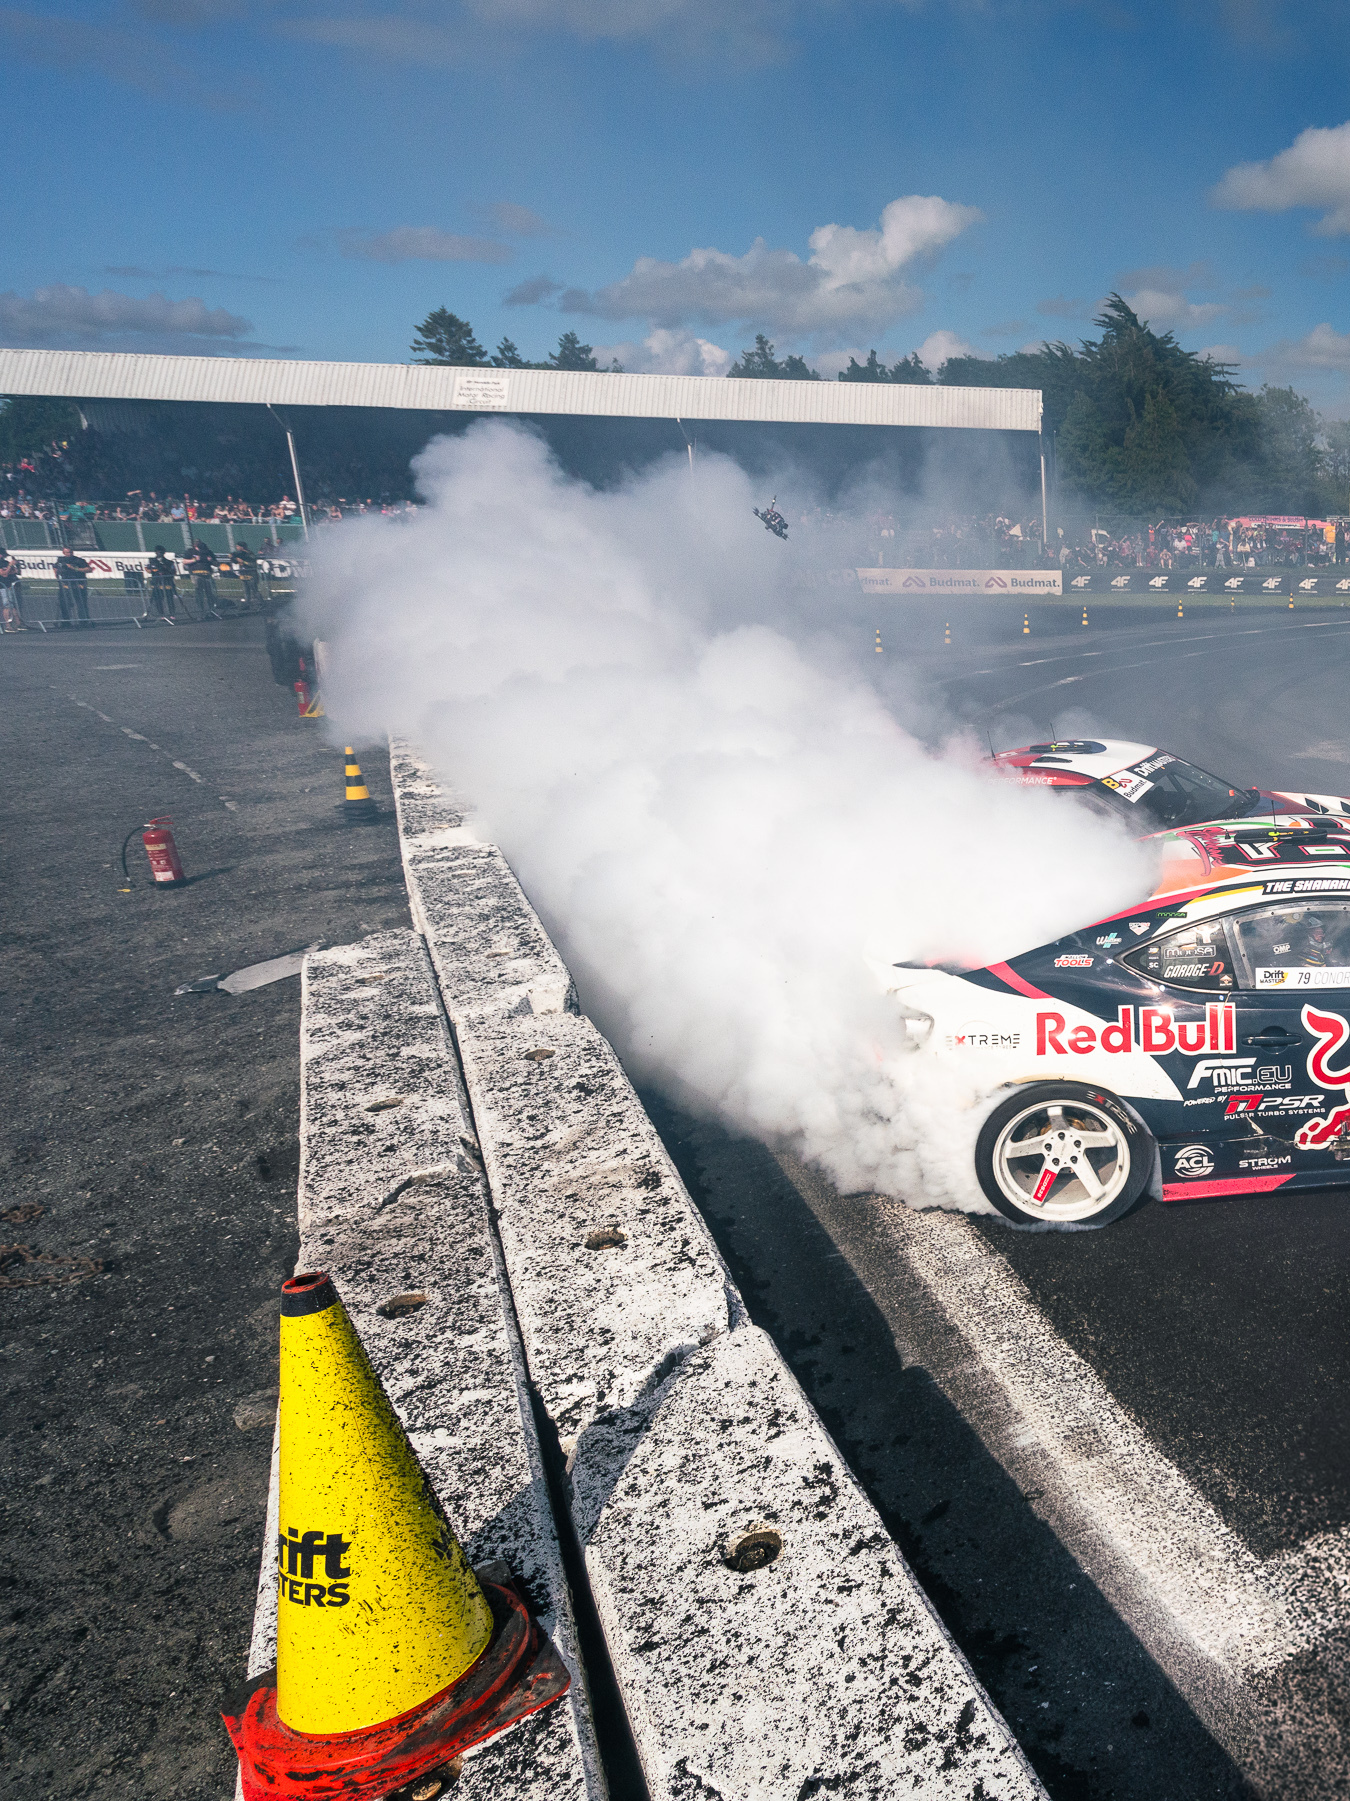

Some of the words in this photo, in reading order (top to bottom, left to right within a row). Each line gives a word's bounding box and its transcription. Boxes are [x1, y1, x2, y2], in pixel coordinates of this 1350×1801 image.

[929, 577, 980, 588] Budmat.
[1010, 577, 1061, 588] Budmat.
[1071, 576, 1091, 587] 4F
[1111, 576, 1131, 587] 4F
[1149, 576, 1168, 587] 4F
[1188, 577, 1207, 588] 4F
[1225, 577, 1244, 588] 4F
[1262, 578, 1282, 589] 4F
[1299, 579, 1318, 589] 4F
[1265, 881, 1292, 893] THE
[1273, 943, 1292, 954] OMP
[1055, 959, 1092, 967] TOOLS
[1164, 961, 1225, 978] GARAGE-D
[1263, 970, 1286, 979] Drift
[1297, 972, 1312, 985] 79
[1314, 972, 1350, 985] CONOR
[1036, 1007, 1132, 1056] Red
[1142, 1004, 1234, 1053] Bull
[1214, 1083, 1292, 1094] PERFORMANCE
[1184, 1096, 1215, 1107] POWERED
[1217, 1095, 1228, 1103] BY
[1258, 1094, 1325, 1110] PSR
[1175, 1155, 1215, 1170] ACL
[1239, 1155, 1292, 1168] STRÖM
[279, 1526, 352, 1580] rift
[279, 1573, 351, 1608] TERS
